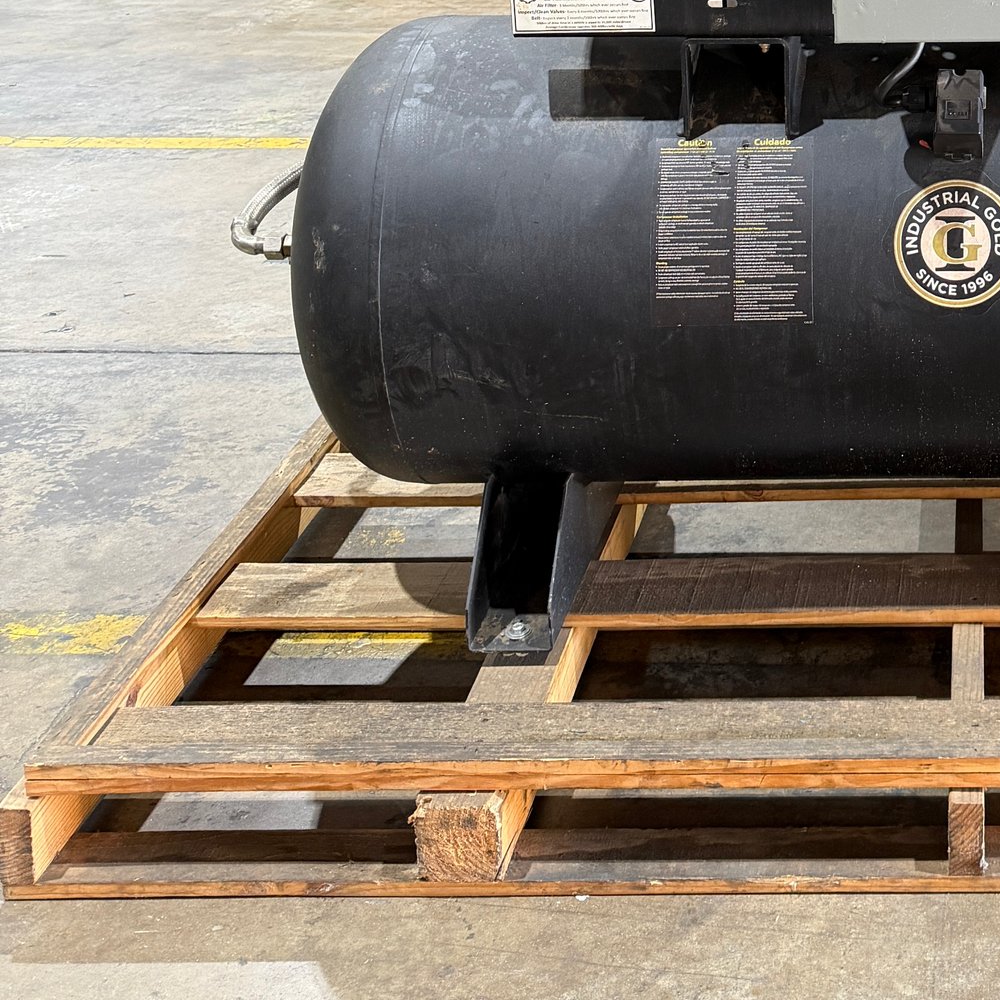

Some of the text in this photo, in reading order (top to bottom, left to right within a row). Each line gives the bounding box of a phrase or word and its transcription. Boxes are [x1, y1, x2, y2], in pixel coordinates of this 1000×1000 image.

[905, 191, 980, 256] INDUSTRIAL
[916, 268, 994, 296] SINCE 1996
